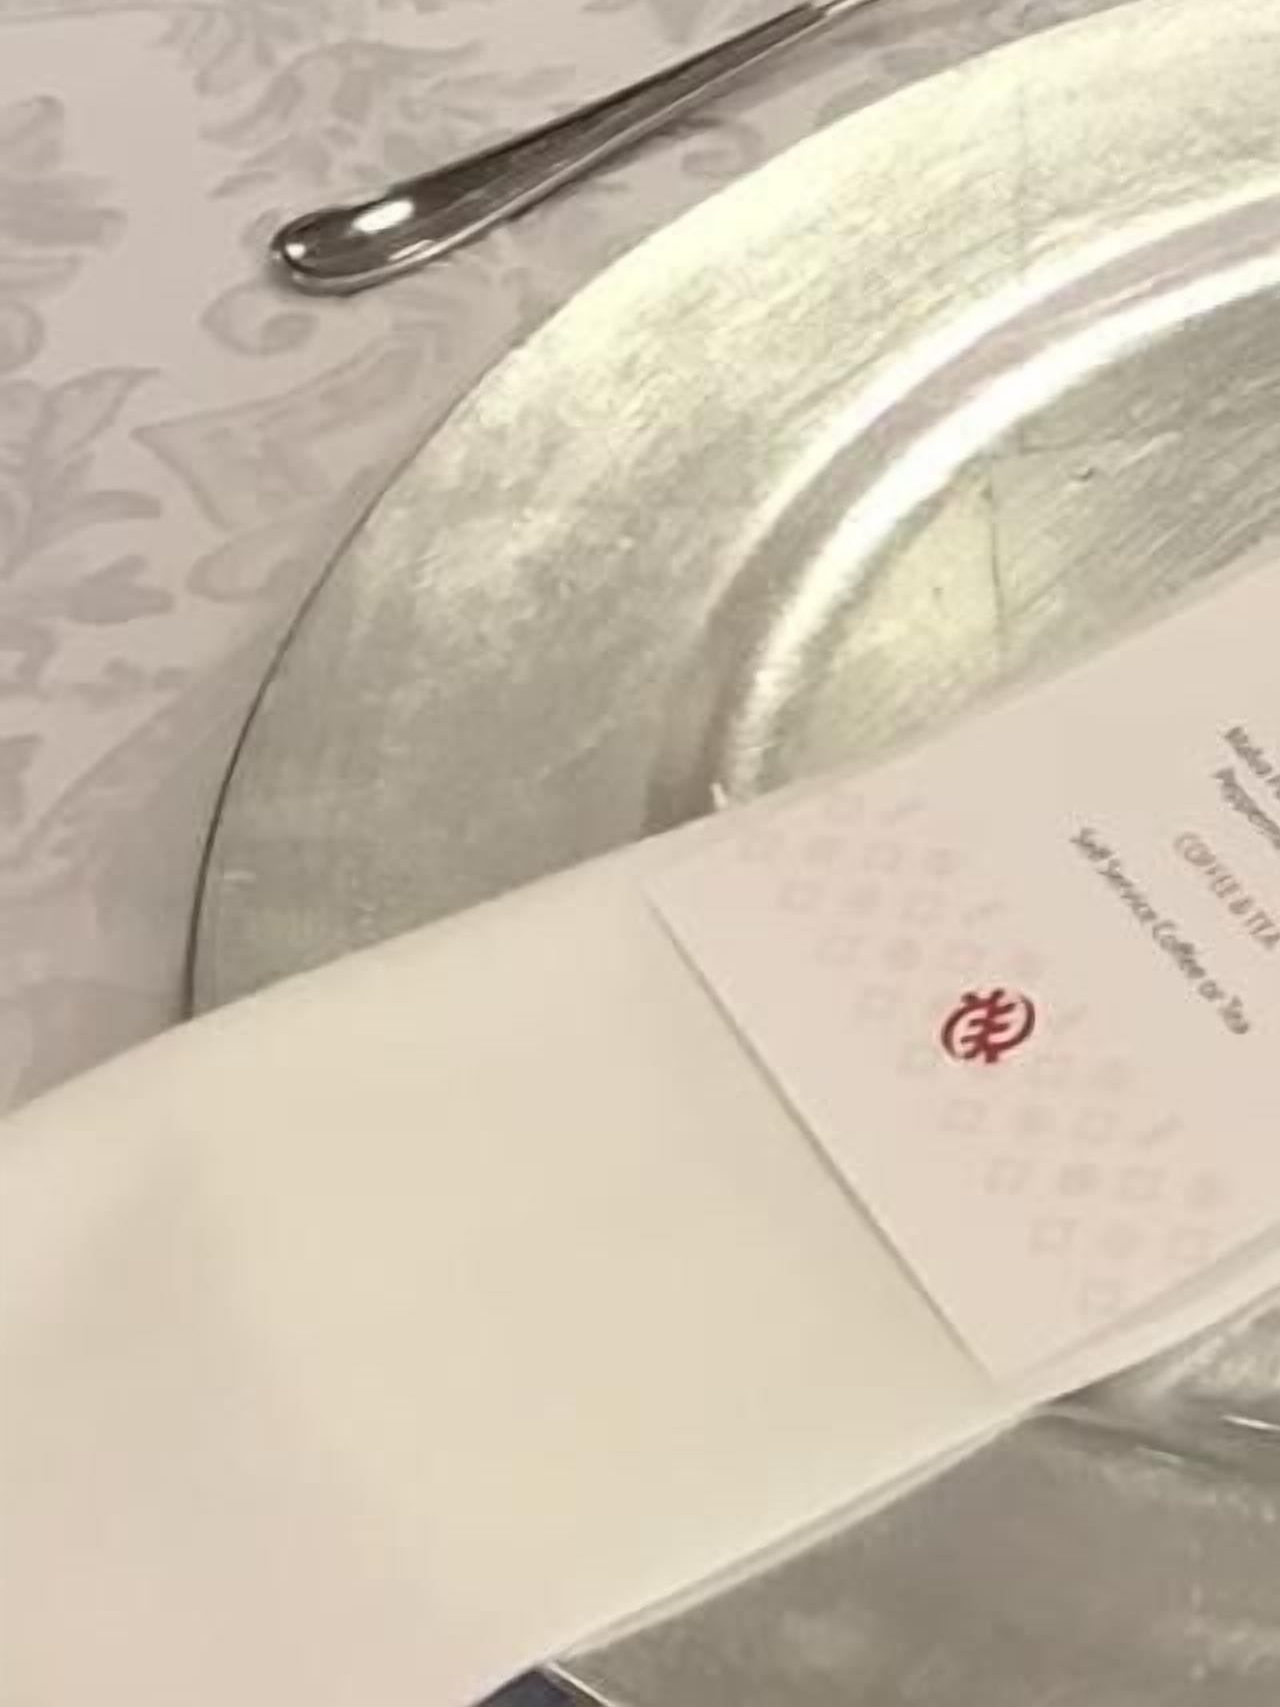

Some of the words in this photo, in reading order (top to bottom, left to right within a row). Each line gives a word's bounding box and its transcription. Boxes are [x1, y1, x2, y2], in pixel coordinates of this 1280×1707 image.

[1223, 725, 1273, 778] Malva
[1173, 831, 1241, 900] COFFEE
[1228, 895, 1254, 916] &
[1070, 826, 1114, 864] Self
[1098, 857, 1159, 925] Service
[1151, 919, 1208, 981] Coffee
[1198, 978, 1225, 1003] or
[1218, 995, 1251, 1035] Tea
